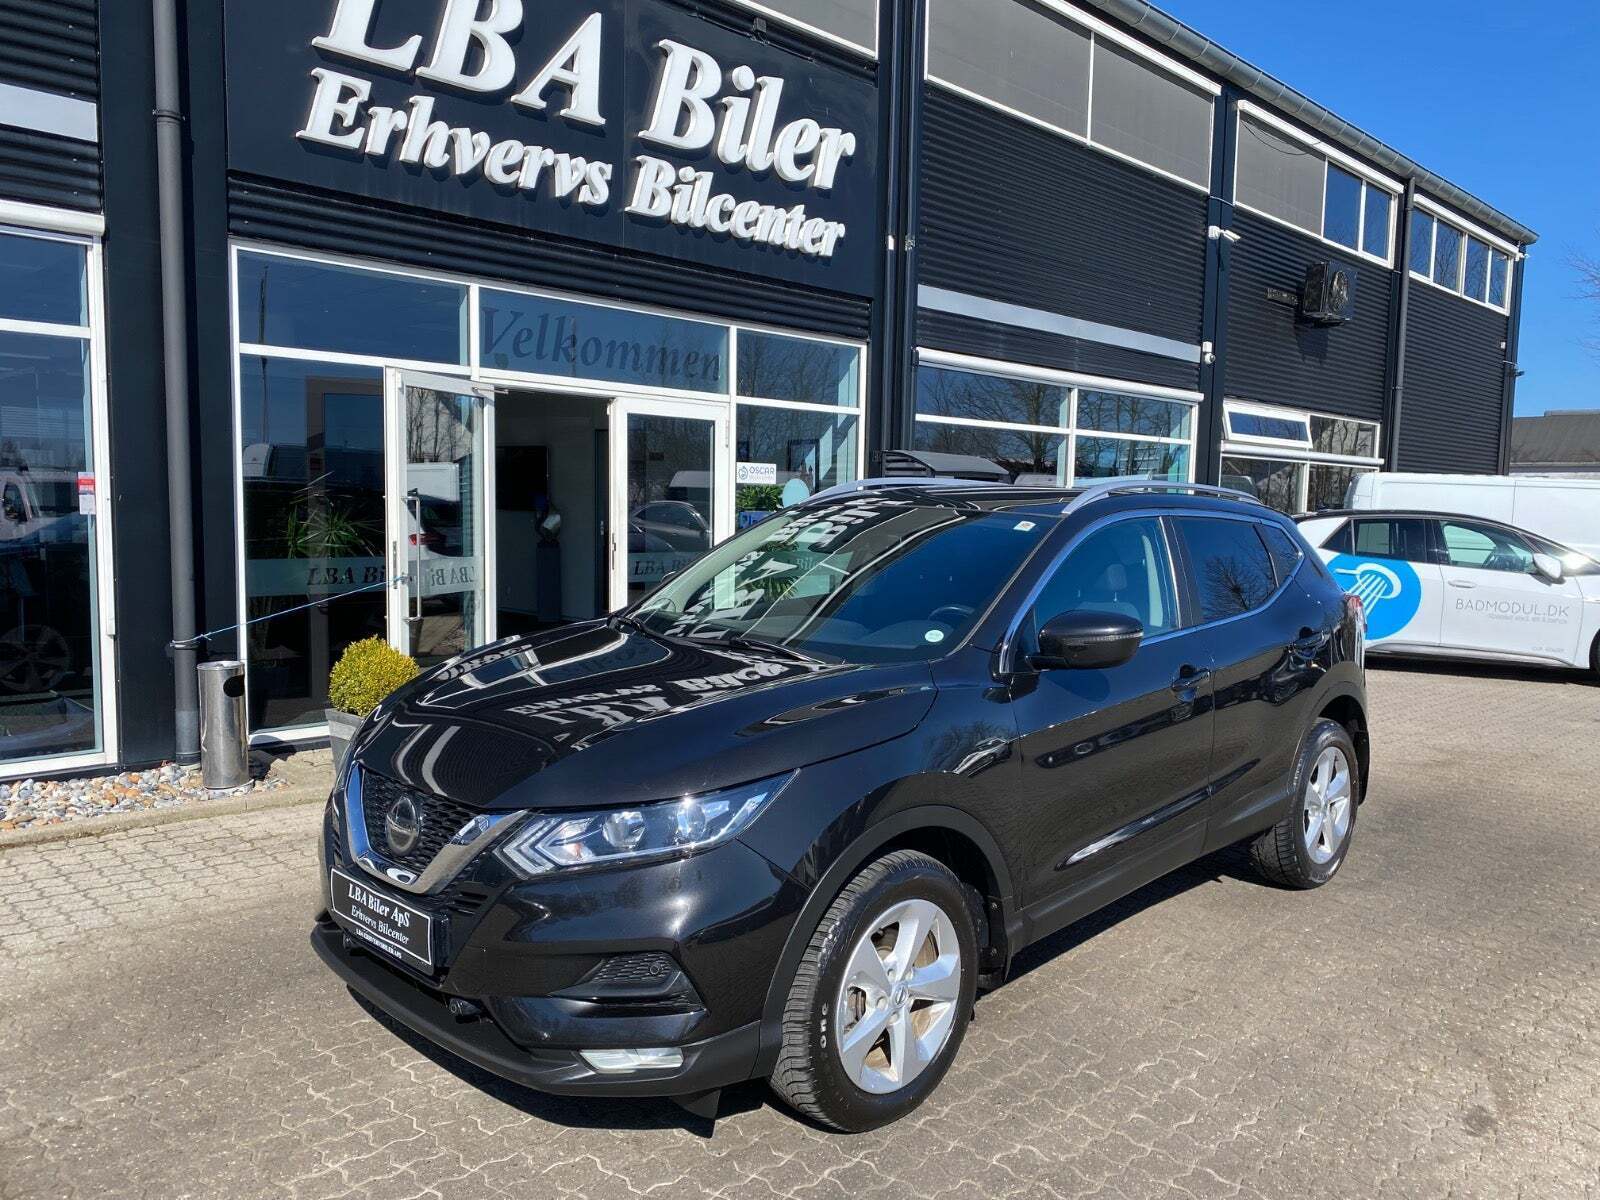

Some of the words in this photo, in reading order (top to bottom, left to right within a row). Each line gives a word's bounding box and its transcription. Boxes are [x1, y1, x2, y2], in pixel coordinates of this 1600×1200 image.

[312, 0, 606, 125] LBA
[638, 39, 856, 189] Biler
[295, 67, 612, 206] Erhvervs
[624, 155, 845, 257] Bilcenter
[481, 307, 721, 382] Velkommen
[749, 466, 775, 475] OSCAR
[307, 566, 354, 586] LBA
[1456, 598, 1570, 617] BADMODUL.DK
[348, 883, 366, 904] LBA
[368, 895, 390, 917] Biler
[391, 906, 410, 928] ApS
[351, 904, 377, 929] Erhvervs
[378, 920, 409, 945] Bilcenter
